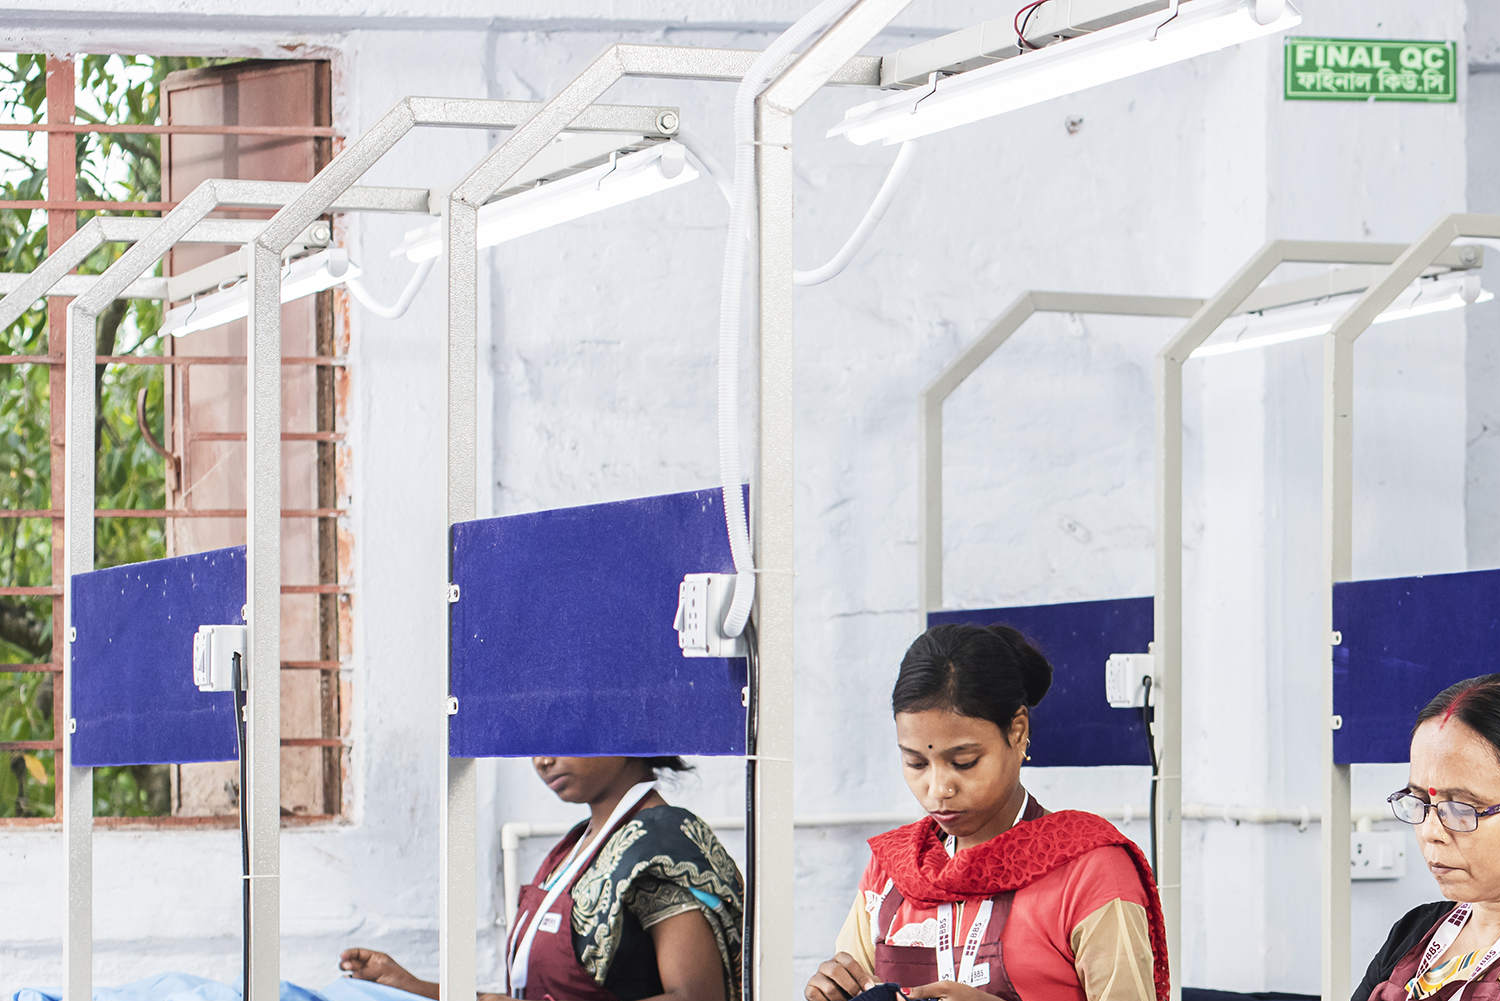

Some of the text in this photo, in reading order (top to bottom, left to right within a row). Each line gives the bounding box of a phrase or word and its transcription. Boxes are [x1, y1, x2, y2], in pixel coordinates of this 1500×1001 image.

[1296, 44, 1445, 69] FINAL QC
[939, 918, 947, 934] BBS
[970, 922, 982, 938] BBS
[1426, 941, 1441, 960] BBS
